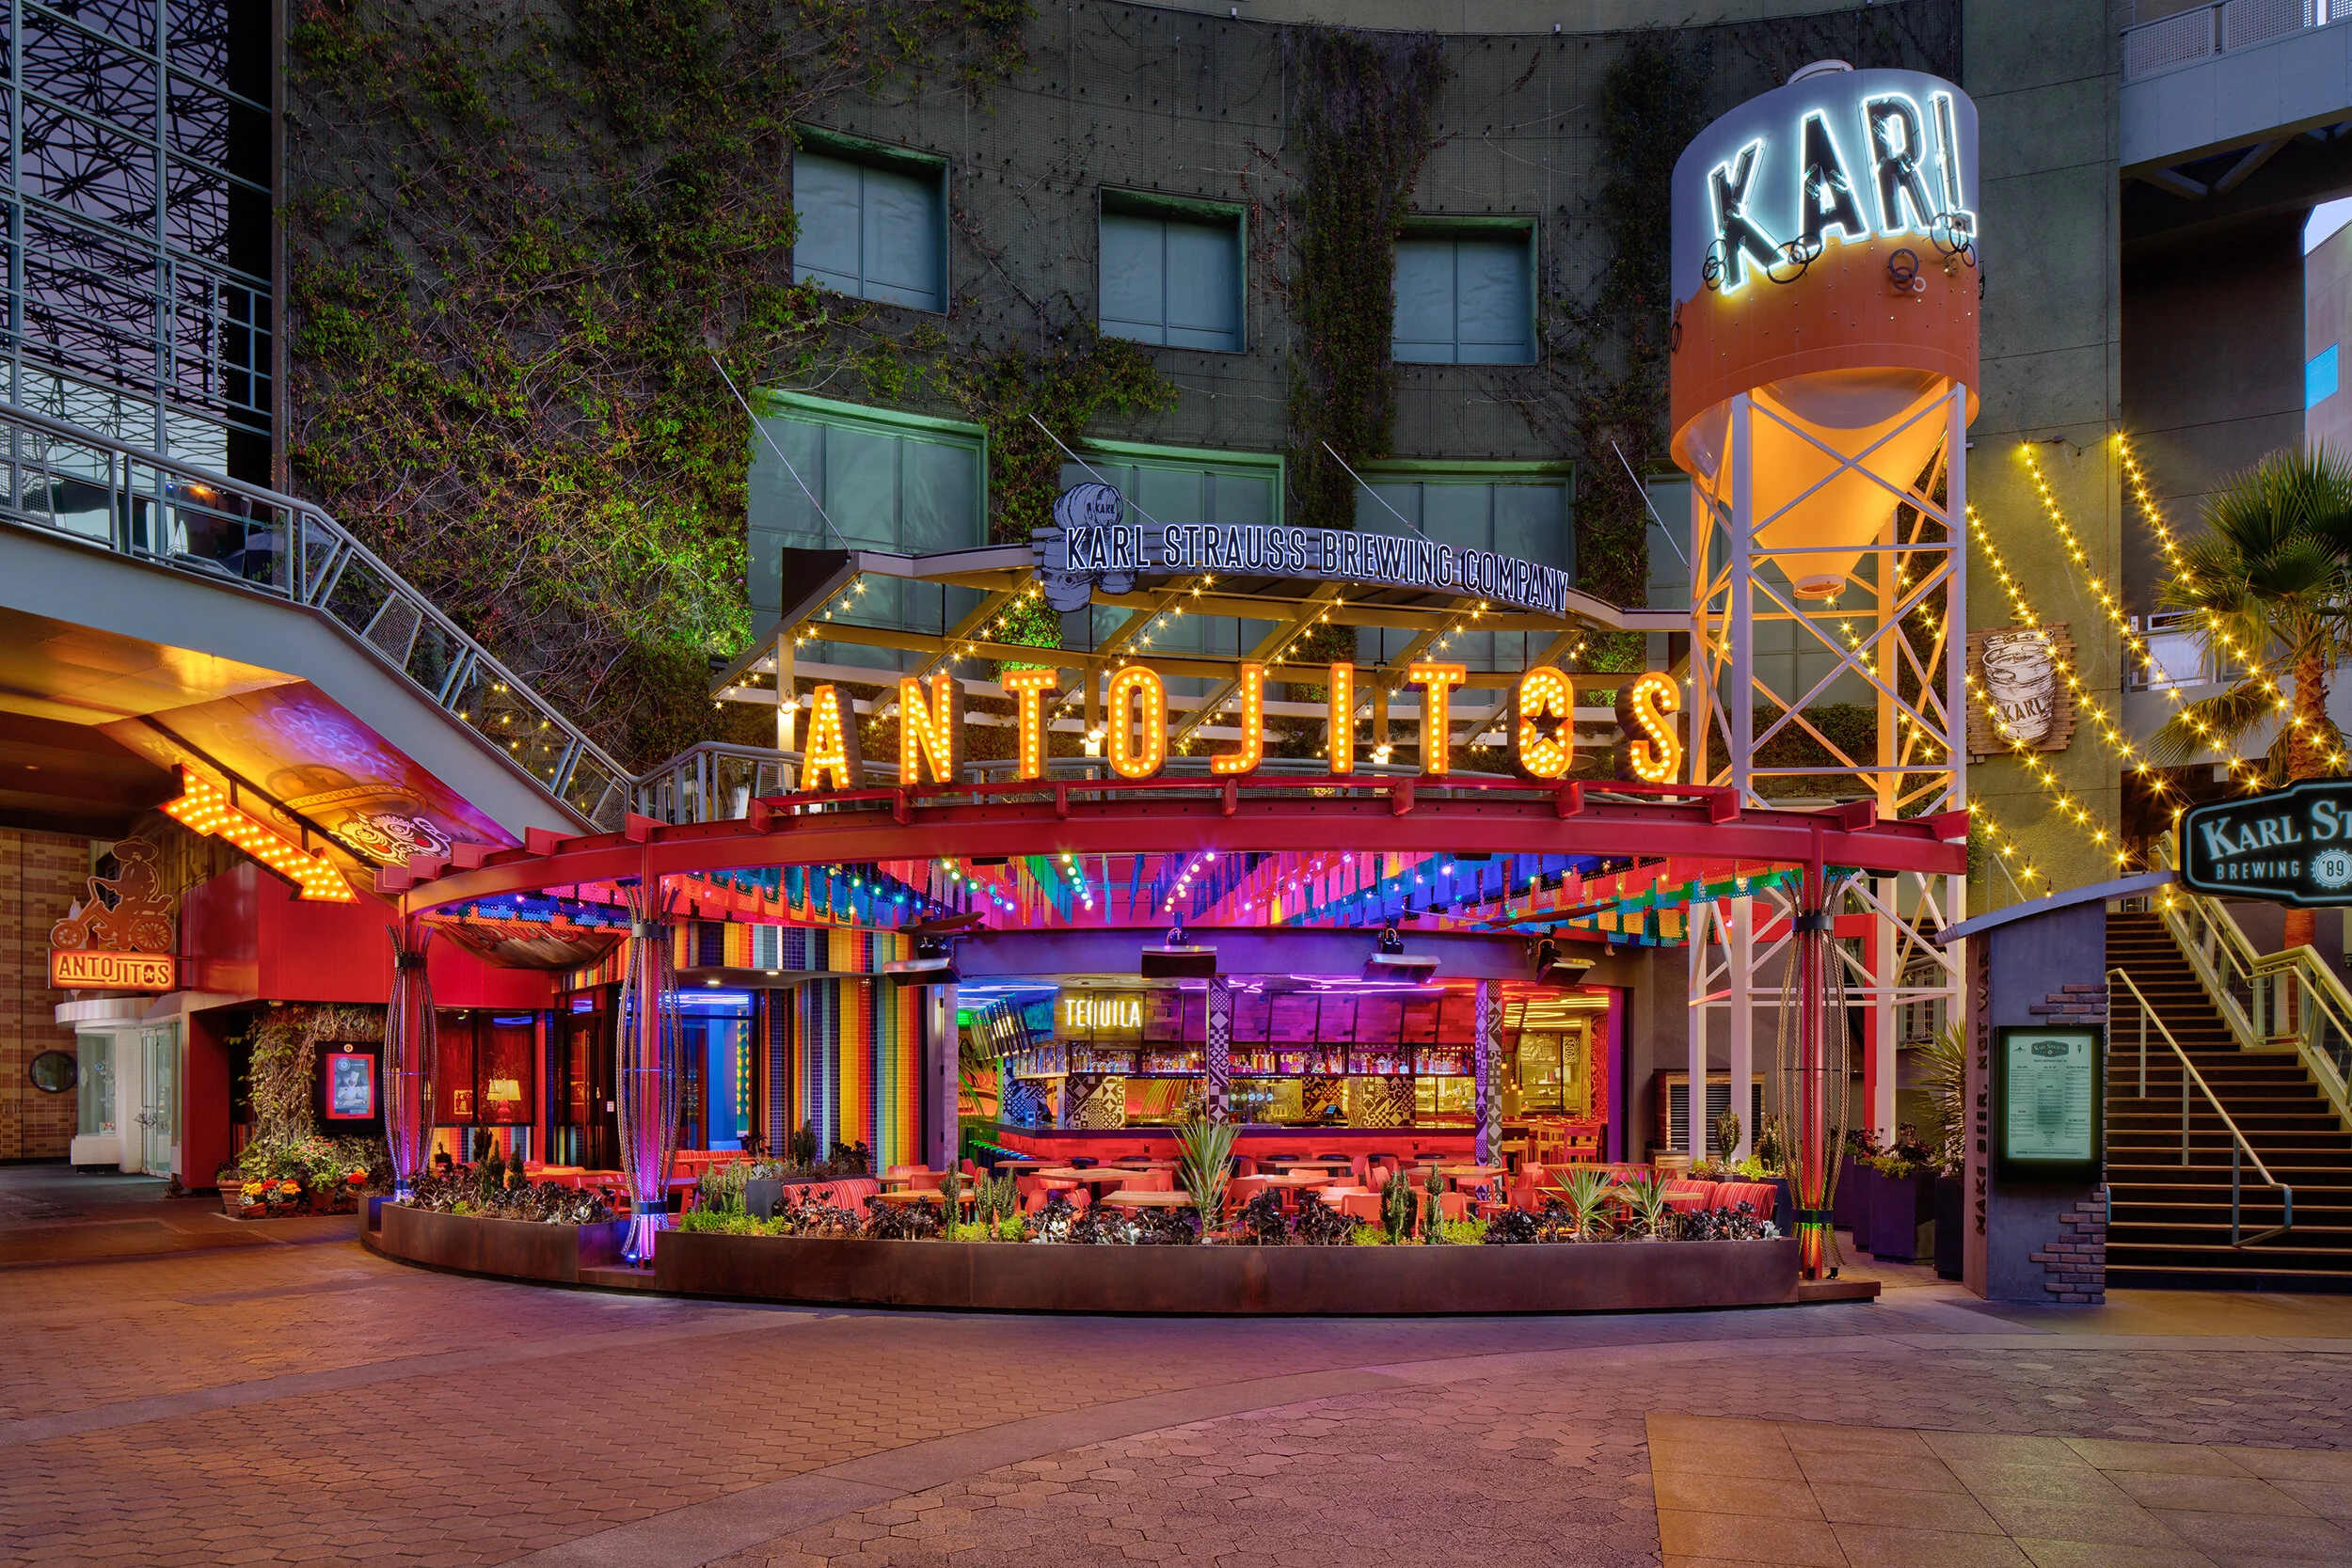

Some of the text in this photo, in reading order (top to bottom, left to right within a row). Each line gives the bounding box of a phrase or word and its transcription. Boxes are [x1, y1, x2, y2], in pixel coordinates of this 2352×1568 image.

[1708, 90, 1977, 295] KARL
[1095, 503, 1116, 515] KARL
[1064, 524, 1570, 612] KARL STRAUSS BREWING COMPANY
[802, 663, 1681, 791] ANTOJITOS
[2001, 700, 2045, 722] KARL
[2200, 816, 2301, 861] KARL
[2217, 861, 2300, 880] BREWING
[58, 955, 169, 985] ANTOJITOS
[1977, 952, 1989, 1012] WAR
[1065, 1000, 1140, 1029] TEQUILA
[1977, 1022, 1989, 1070] NOT
[1975, 1166, 1988, 1235] MAKE
